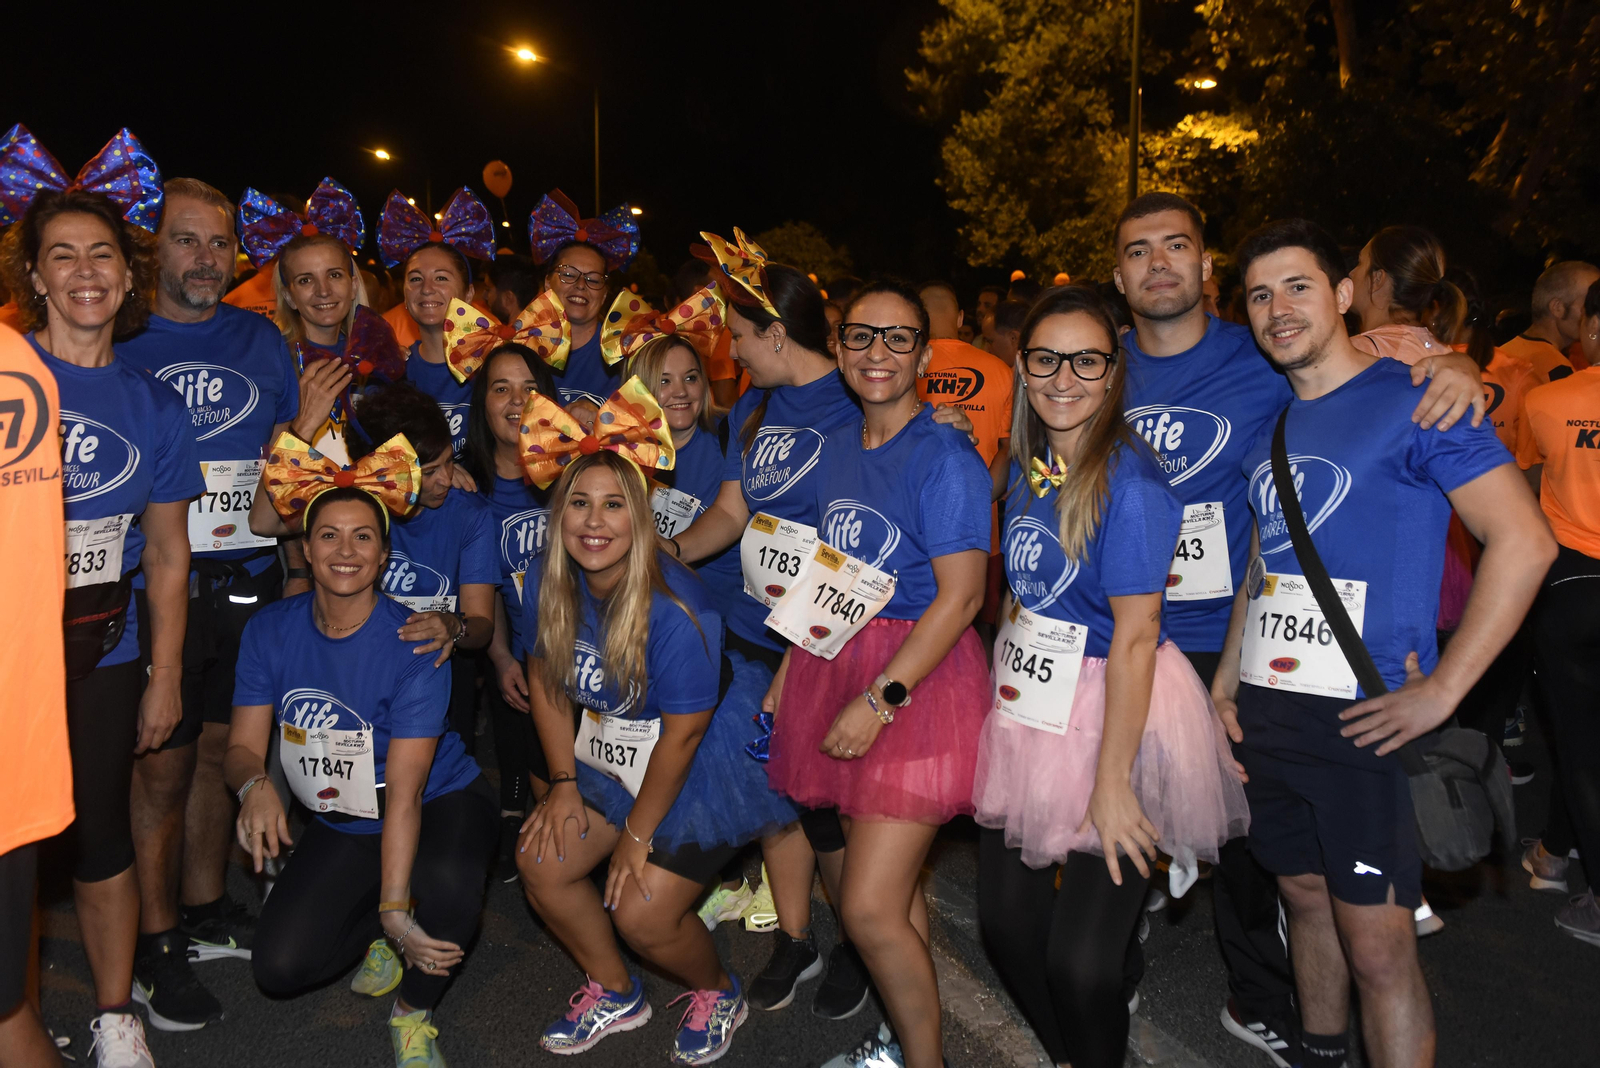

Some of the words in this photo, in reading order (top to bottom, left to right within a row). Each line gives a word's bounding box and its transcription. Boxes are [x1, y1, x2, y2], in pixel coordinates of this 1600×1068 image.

[192, 407, 230, 427] REFOUR
[746, 466, 791, 492] CARREFOUR
[198, 490, 252, 513] 17923
[654, 511, 676, 538] 851
[380, 561, 417, 592] ife
[814, 582, 866, 626] 17840
[1260, 611, 1333, 647] 17846
[1000, 638, 1055, 683] 17845
[589, 735, 638, 768] 17837
[298, 756, 354, 781] 17847
